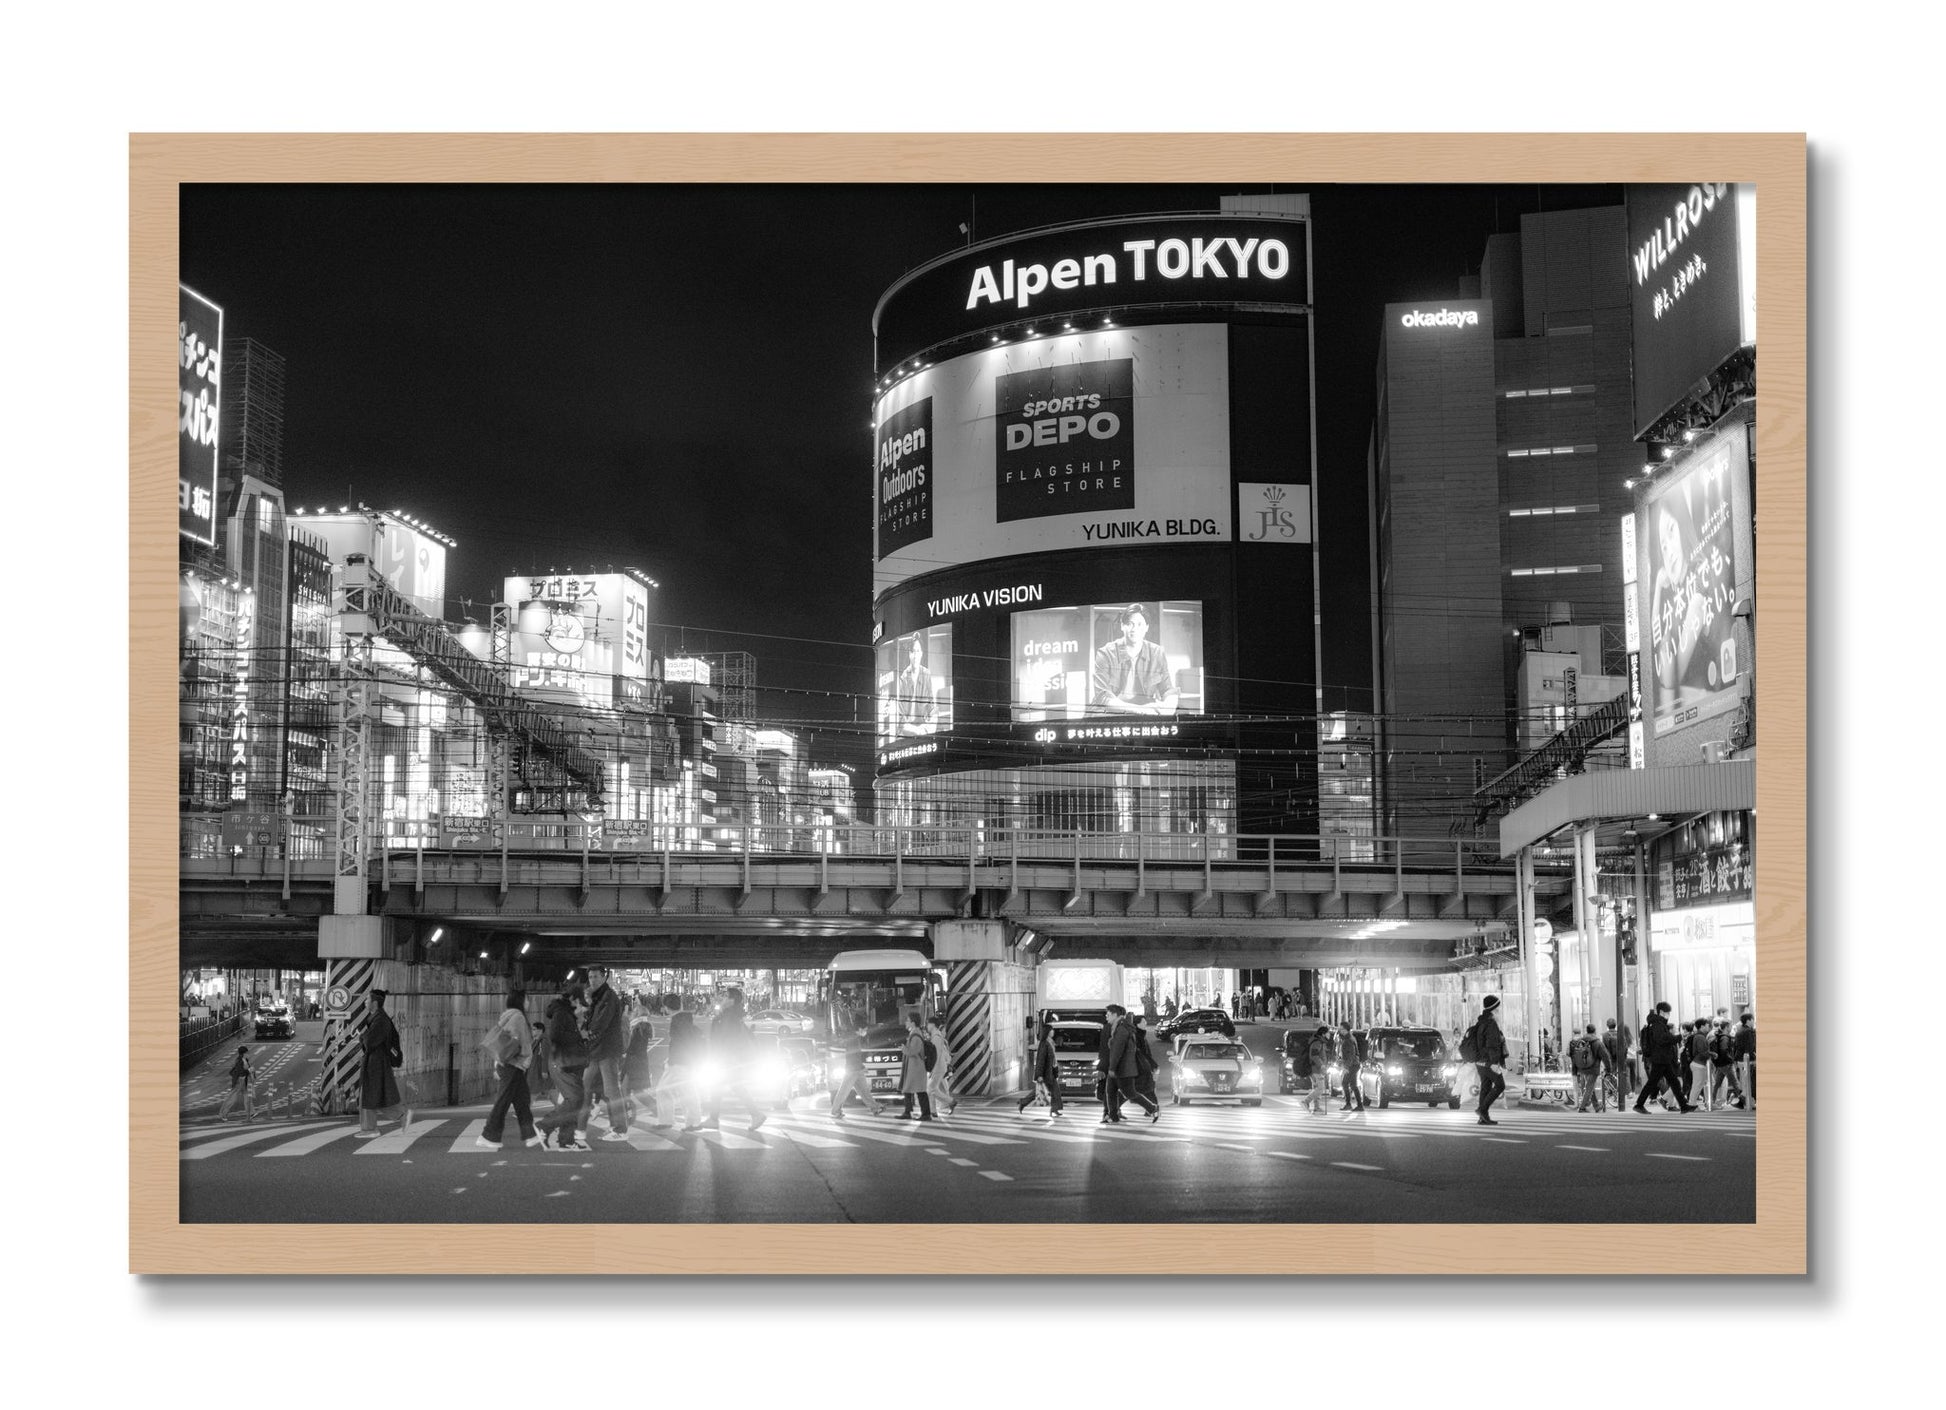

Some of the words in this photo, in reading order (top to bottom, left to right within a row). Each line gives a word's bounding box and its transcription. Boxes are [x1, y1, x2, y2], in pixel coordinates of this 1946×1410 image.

[966, 254, 1117, 309] Alpen
[1124, 238, 1289, 281] TOKYO
[1401, 308, 1479, 329] okadaya
[1022, 393, 1101, 418] SPORTS
[1006, 411, 1121, 452] DEPO
[880, 427, 926, 472] Alpen
[1006, 459, 1123, 483] FLAGSHIP
[882, 464, 926, 504] Outdoors
[1047, 476, 1123, 495] STORE
[880, 492, 927, 525] FLAGSHIP
[892, 508, 927, 532] STORE
[1082, 520, 1161, 541] YUNIKA
[1165, 518, 1221, 537] BLDG.
[298, 585, 327, 604] SHISHA
[530, 578, 598, 598] プロミス
[928, 593, 980, 618] YUNIKA
[983, 584, 1042, 607] VISION
[626, 595, 645, 666] プロミス
[1654, 583, 1735, 677] いいじゃない。
[1024, 640, 1079, 656] dream
[1035, 728, 1057, 743] dip
